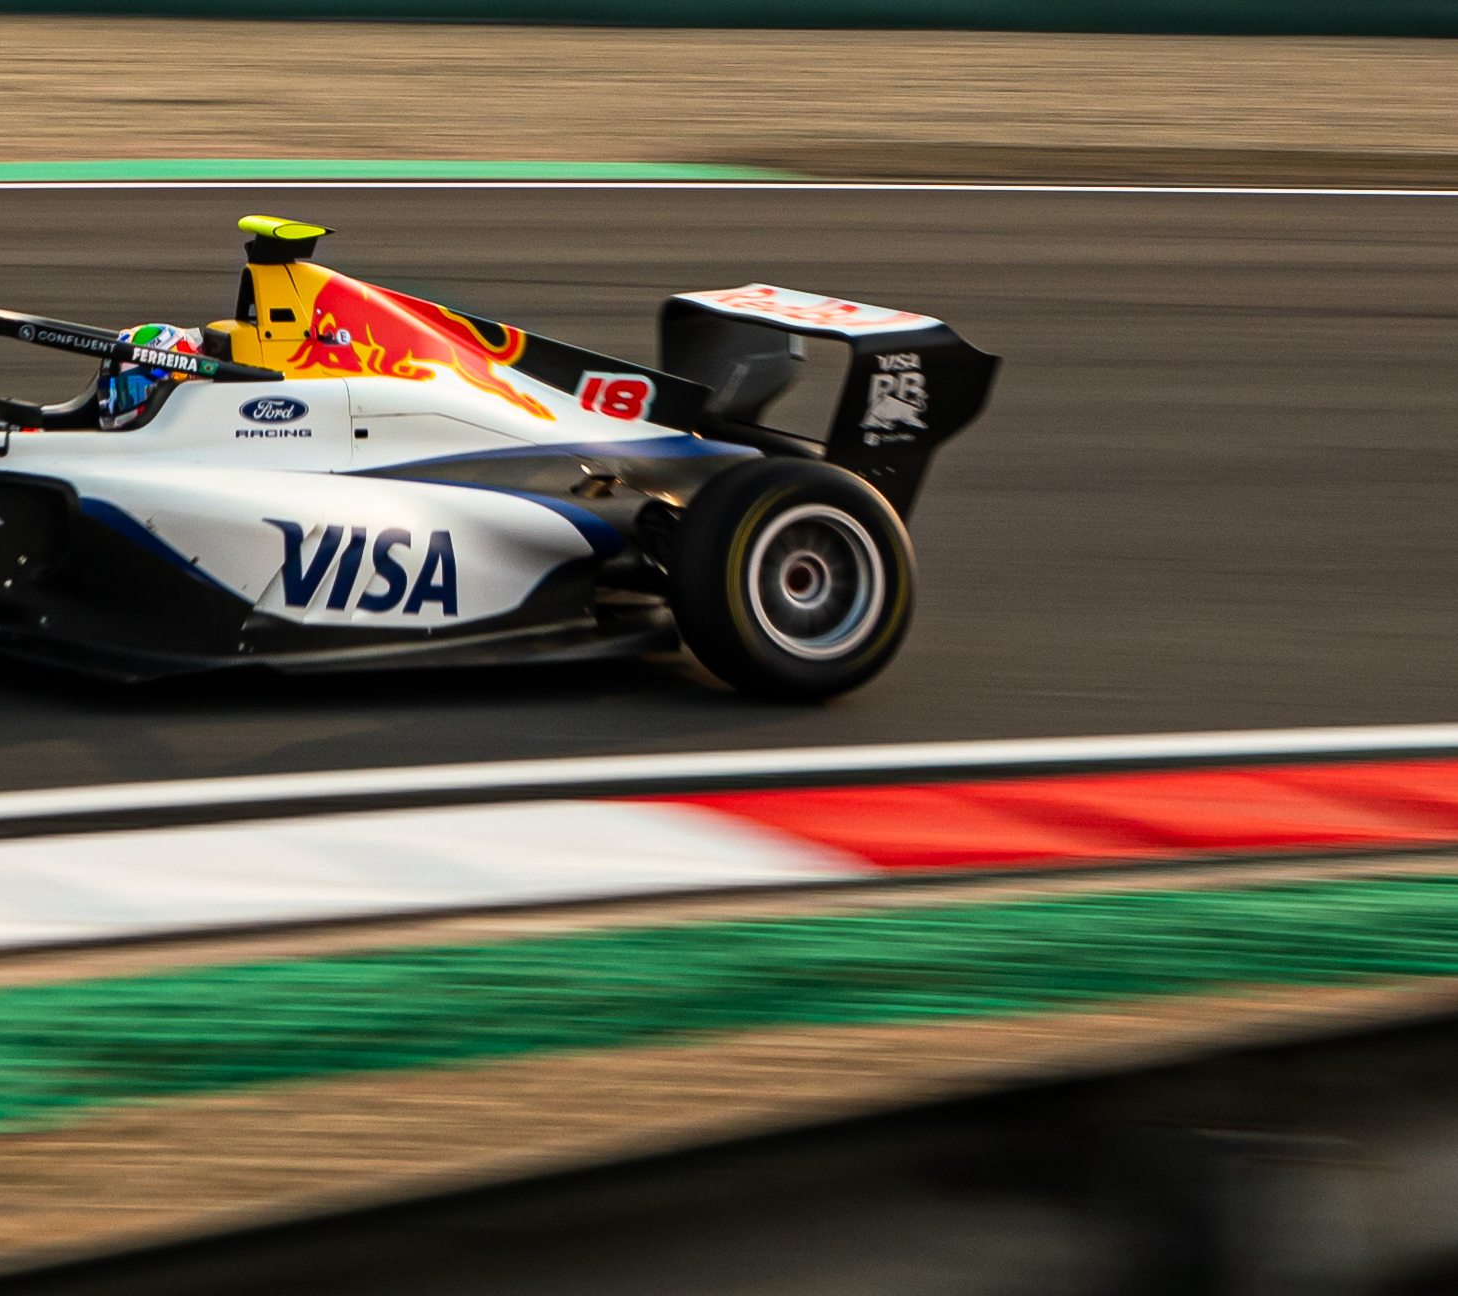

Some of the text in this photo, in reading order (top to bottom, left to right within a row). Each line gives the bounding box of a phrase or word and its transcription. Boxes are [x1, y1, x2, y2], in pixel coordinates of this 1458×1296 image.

[37, 330, 118, 354] CONFLUENT
[132, 347, 199, 373] FERREIRA
[252, 399, 295, 420] Ford
[580, 376, 650, 421] 18
[235, 428, 312, 439] RACING
[261, 516, 459, 618] VISA
